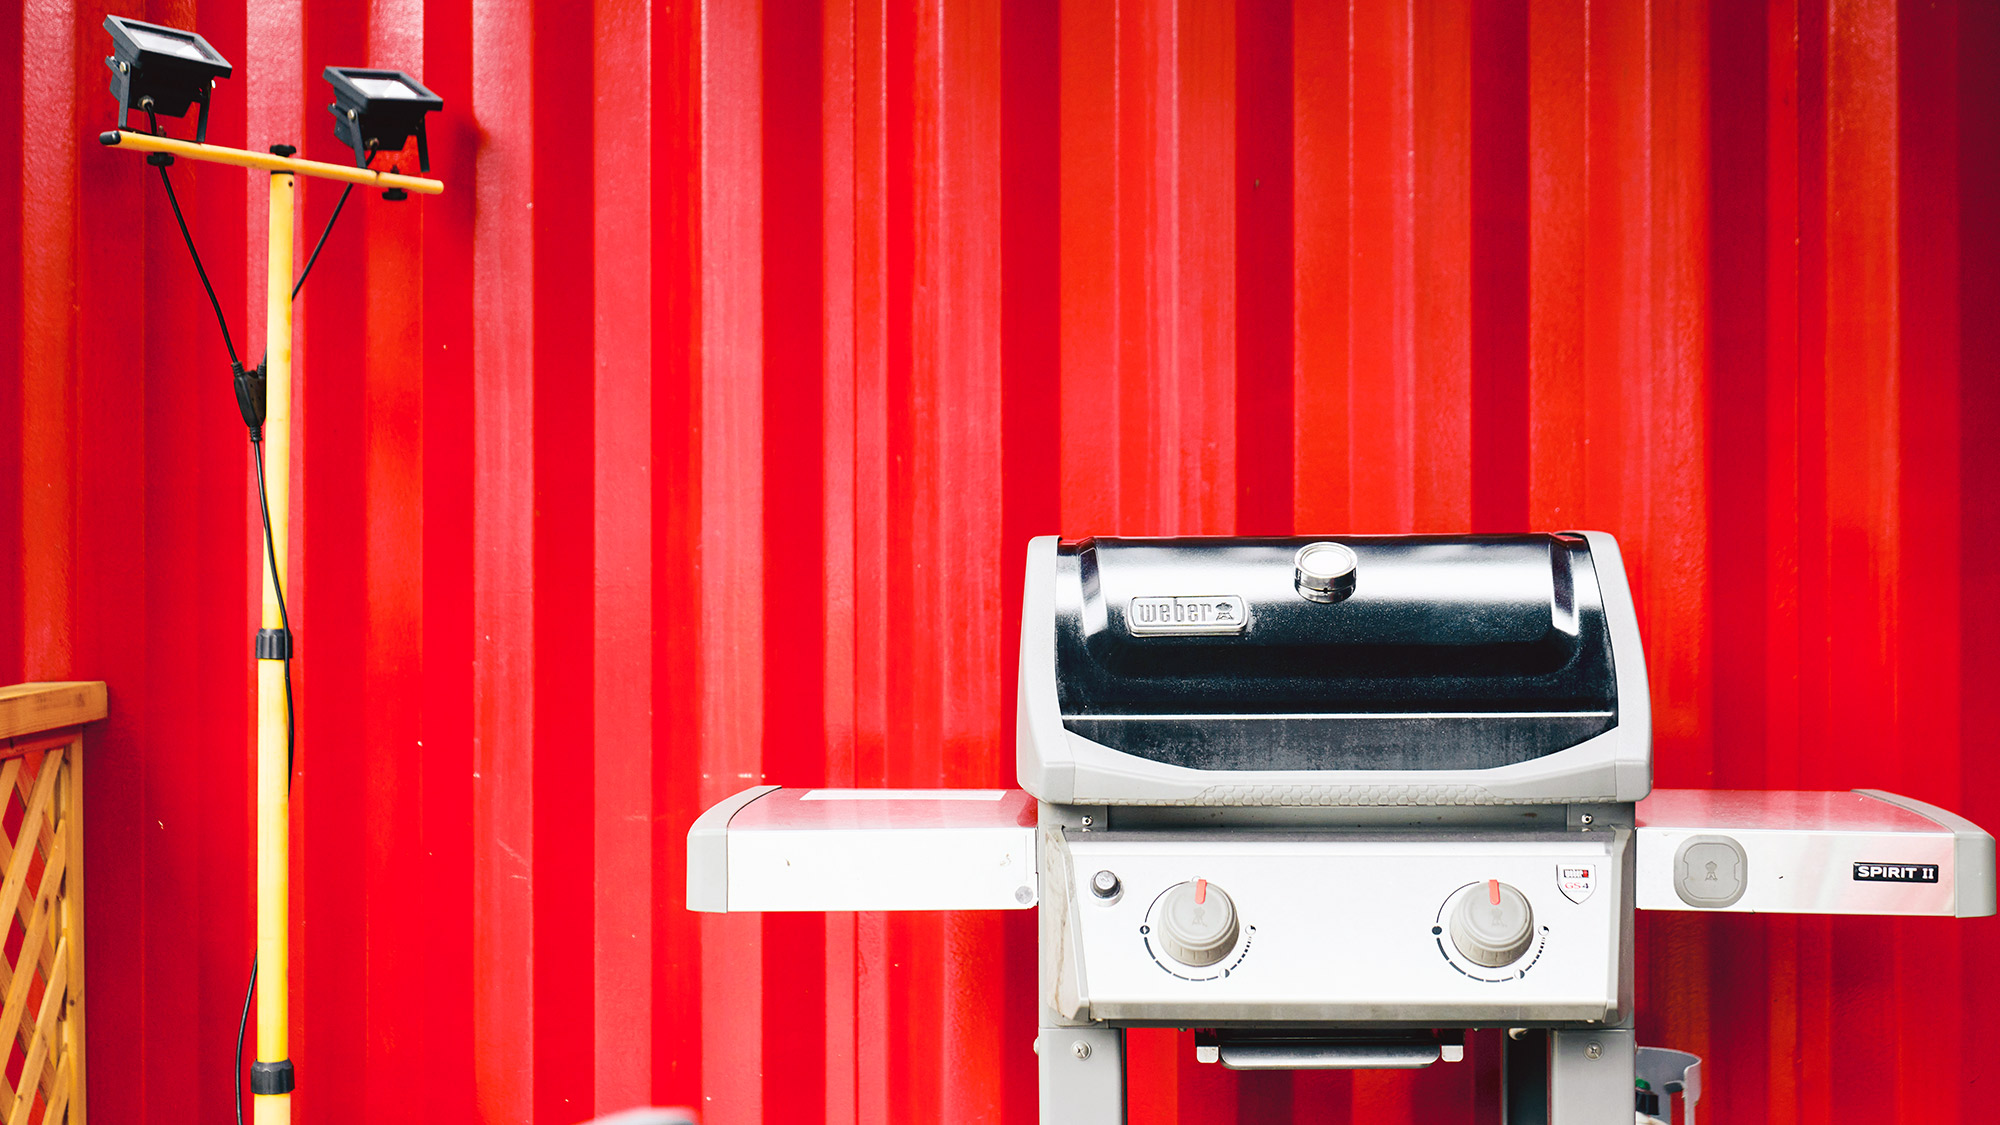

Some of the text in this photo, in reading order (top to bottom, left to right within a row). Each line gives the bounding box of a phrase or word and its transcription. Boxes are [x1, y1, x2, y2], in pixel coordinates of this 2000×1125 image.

[1138, 597, 1212, 622] weber
[1858, 866, 1934, 880] SPIRIT II
